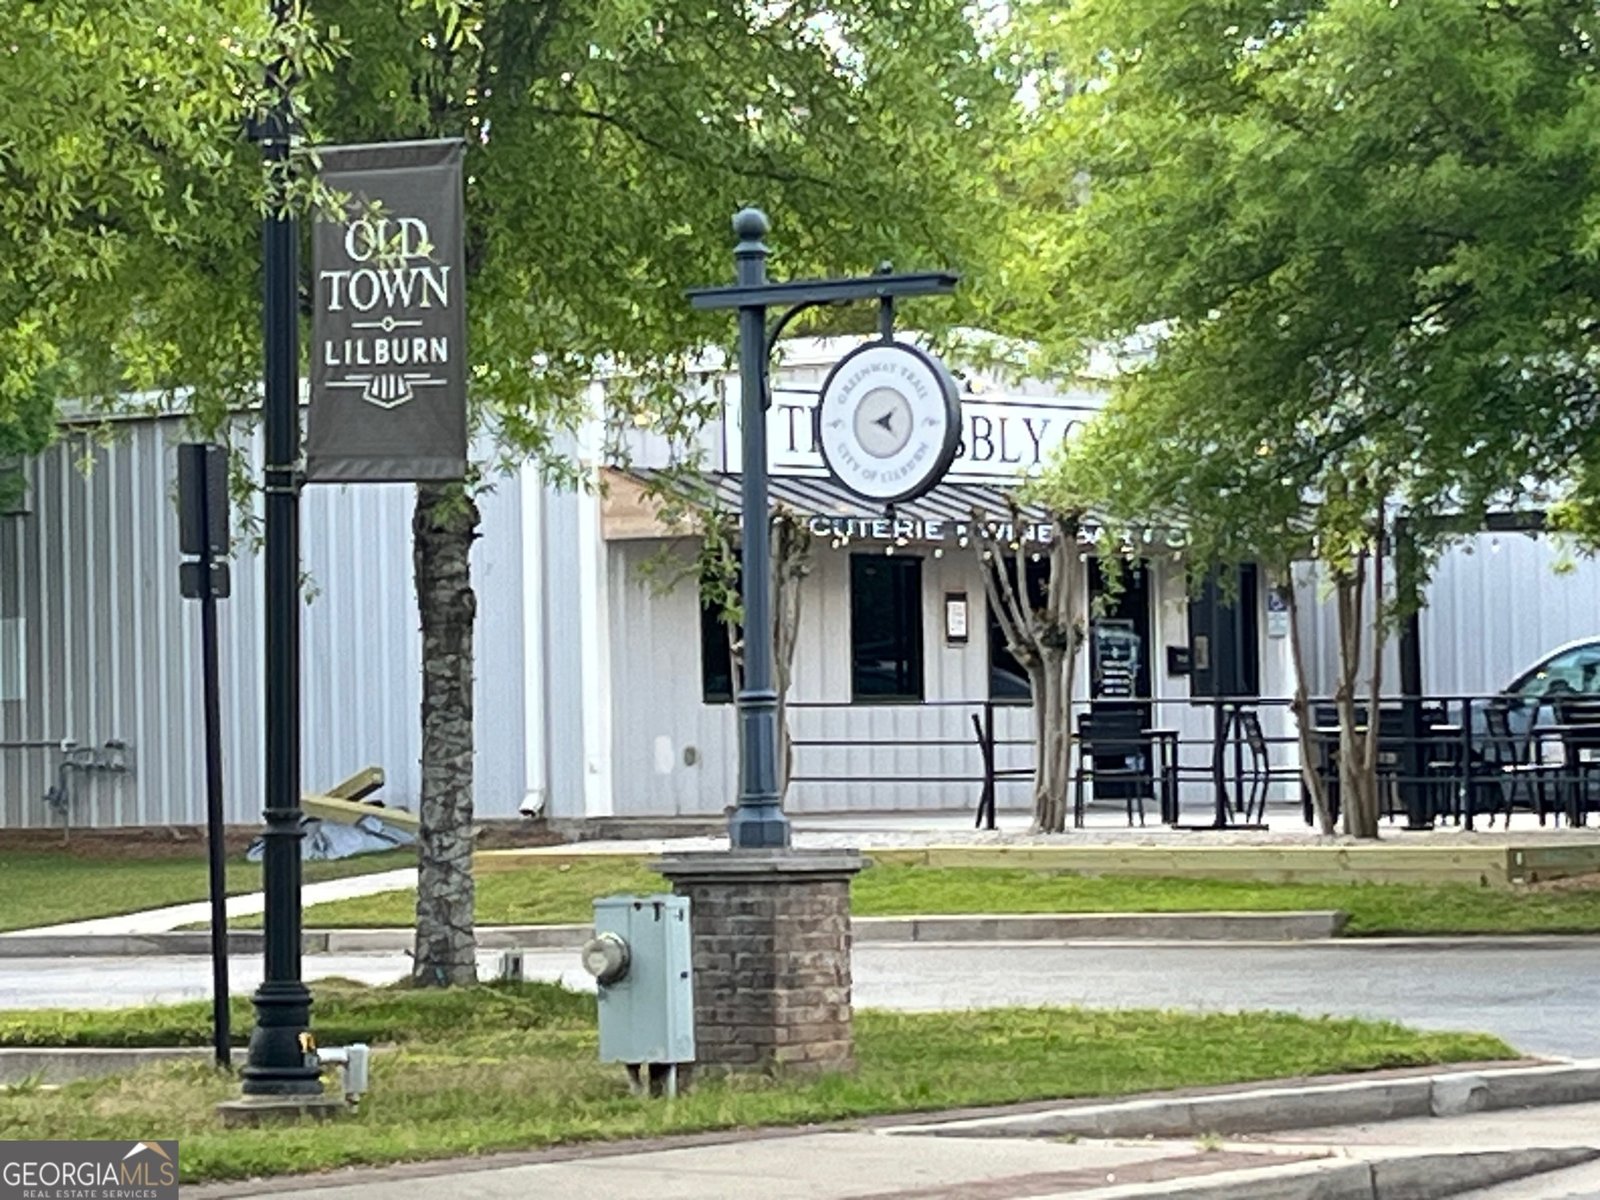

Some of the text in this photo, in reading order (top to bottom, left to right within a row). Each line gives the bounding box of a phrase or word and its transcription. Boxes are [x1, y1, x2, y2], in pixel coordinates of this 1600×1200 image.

[345, 217, 429, 262] OLD
[320, 266, 451, 311] TOWN
[325, 337, 448, 365] LILBURN
[838, 363, 929, 405] GREENWAY TRAIL
[838, 442, 930, 483] CITY OF LILBURN
